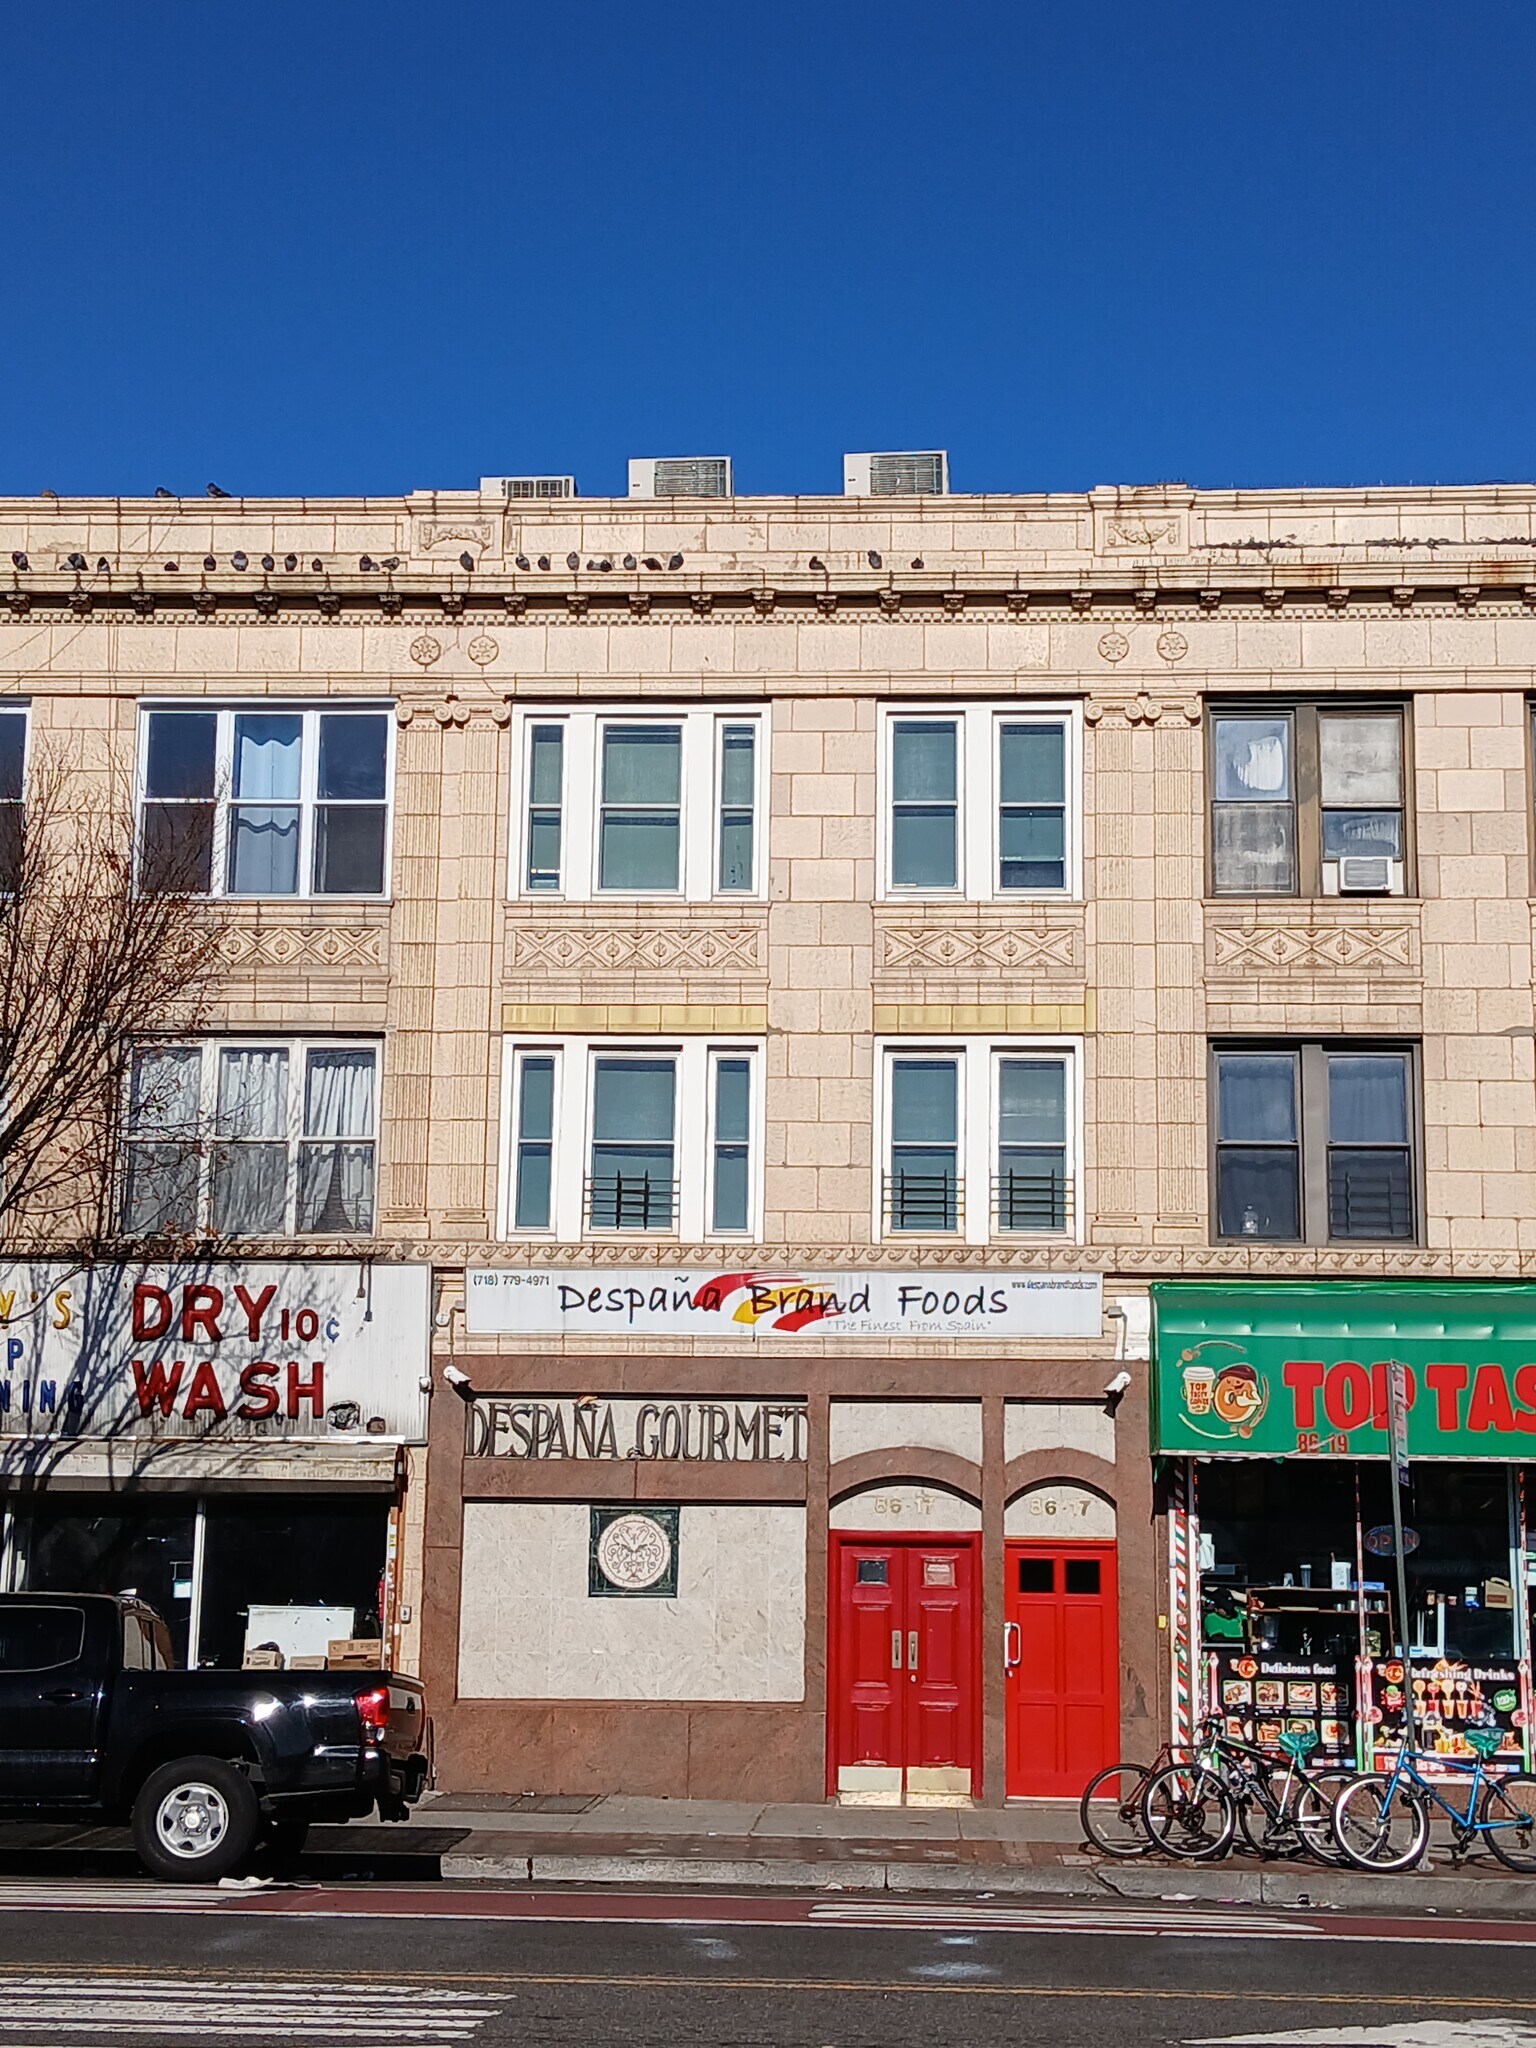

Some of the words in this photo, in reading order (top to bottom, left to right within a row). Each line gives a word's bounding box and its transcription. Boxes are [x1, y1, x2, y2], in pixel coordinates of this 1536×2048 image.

[473, 1273, 498, 1286] (718)
[502, 1274, 550, 1286] 779-4971
[132, 1284, 277, 1342] DRY
[558, 1275, 721, 1324] Despaña
[746, 1283, 871, 1316] Brand
[897, 1285, 1009, 1317] Foods
[860, 1318, 901, 1331] Finest
[909, 1320, 943, 1332] From
[131, 1360, 324, 1421] WASH
[1283, 1361, 1416, 1431] TOP
[635, 1403, 808, 1460] GOURMET
[1366, 1533, 1417, 1547] OPN
[1260, 1661, 1312, 1675] Delicious
[1473, 1667, 1516, 1681] Drinks
